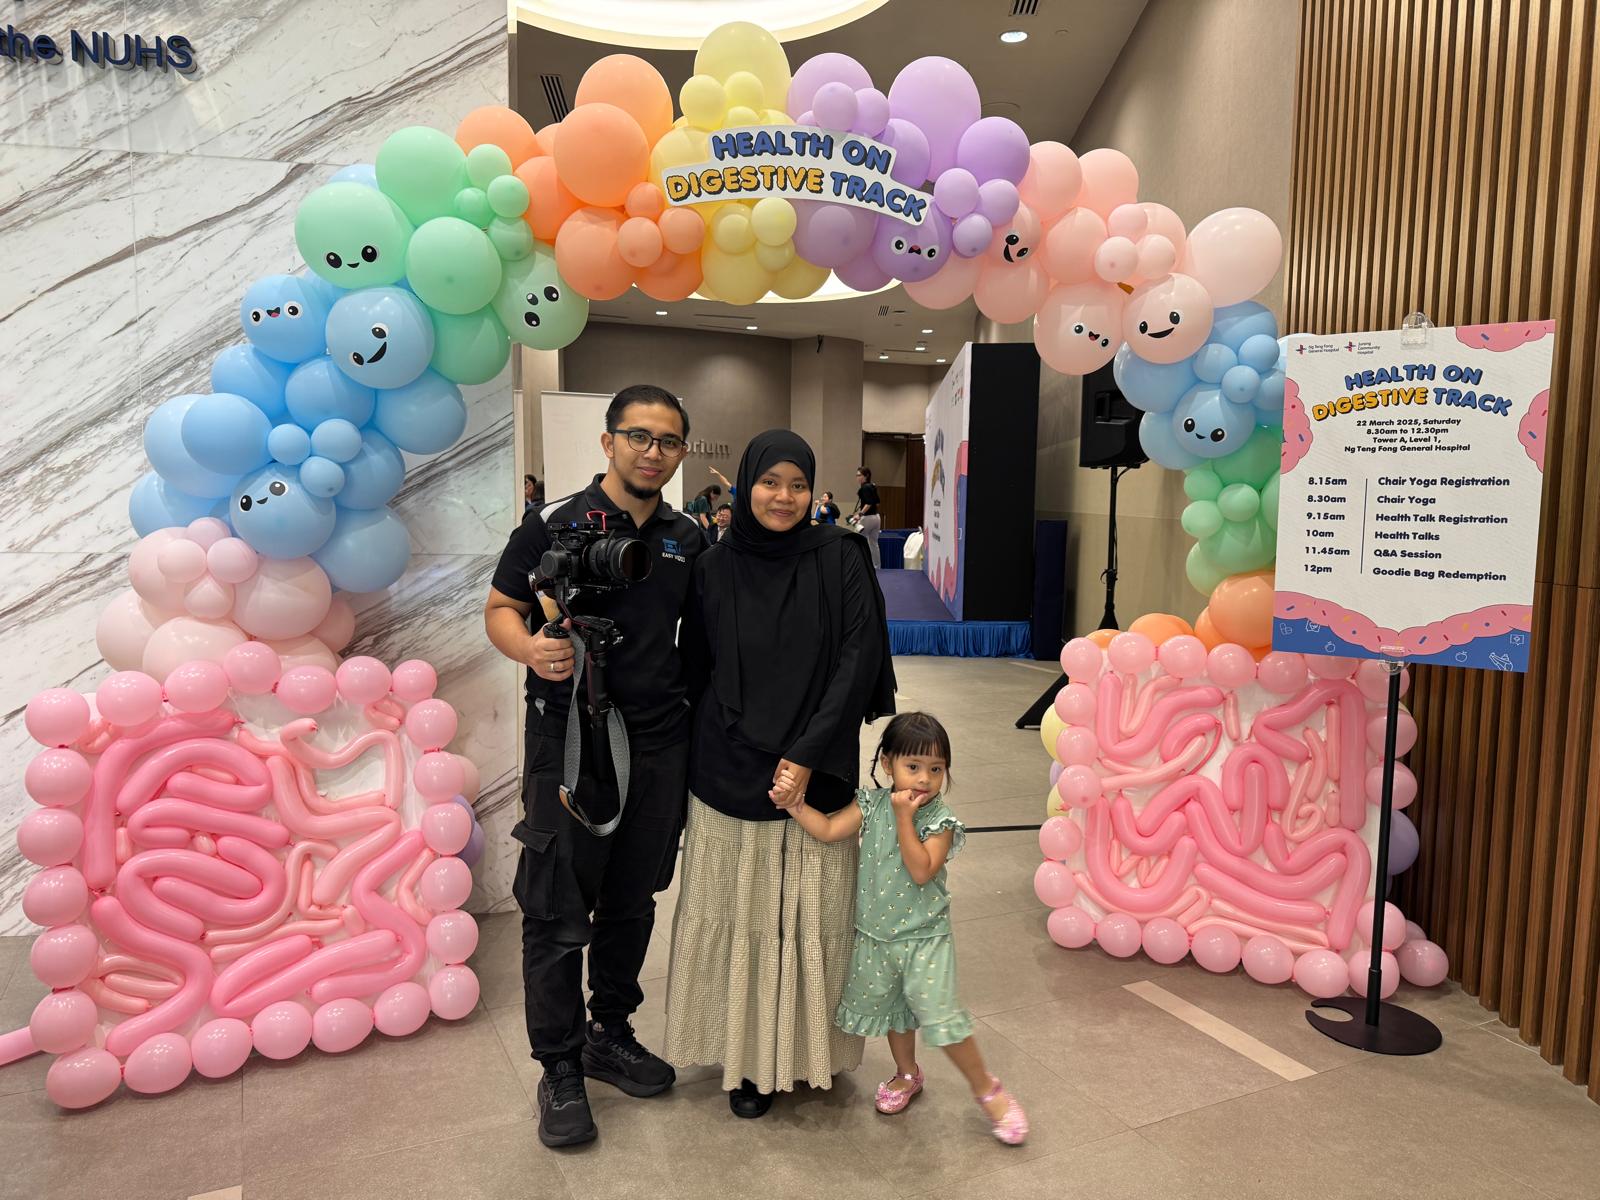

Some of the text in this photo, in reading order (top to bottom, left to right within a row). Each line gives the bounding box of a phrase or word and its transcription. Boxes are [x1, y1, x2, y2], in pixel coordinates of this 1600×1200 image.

[70, 29, 195, 70] NUHS
[712, 130, 891, 174] HEALTH ON
[666, 166, 926, 222] DIGESTIVE TRACK
[1345, 364, 1483, 390] HEALTH ON
[1312, 387, 1512, 421] DIGESTIVE TRACK
[1423, 418, 1461, 426] Saturday
[1435, 444, 1470, 452] Hospital
[1308, 476, 1510, 488] 8.15am Chair Yoga Registration
[1308, 495, 1436, 506] 8.30am Chair Yoga
[1307, 512, 1508, 525] 9.15am Health Talk Registration
[1306, 530, 1440, 541] 10am Health Talks
[1305, 547, 1442, 559] 11.45am Q&A Session
[1304, 564, 1506, 582] 12pm Goodie Bag Redemption
